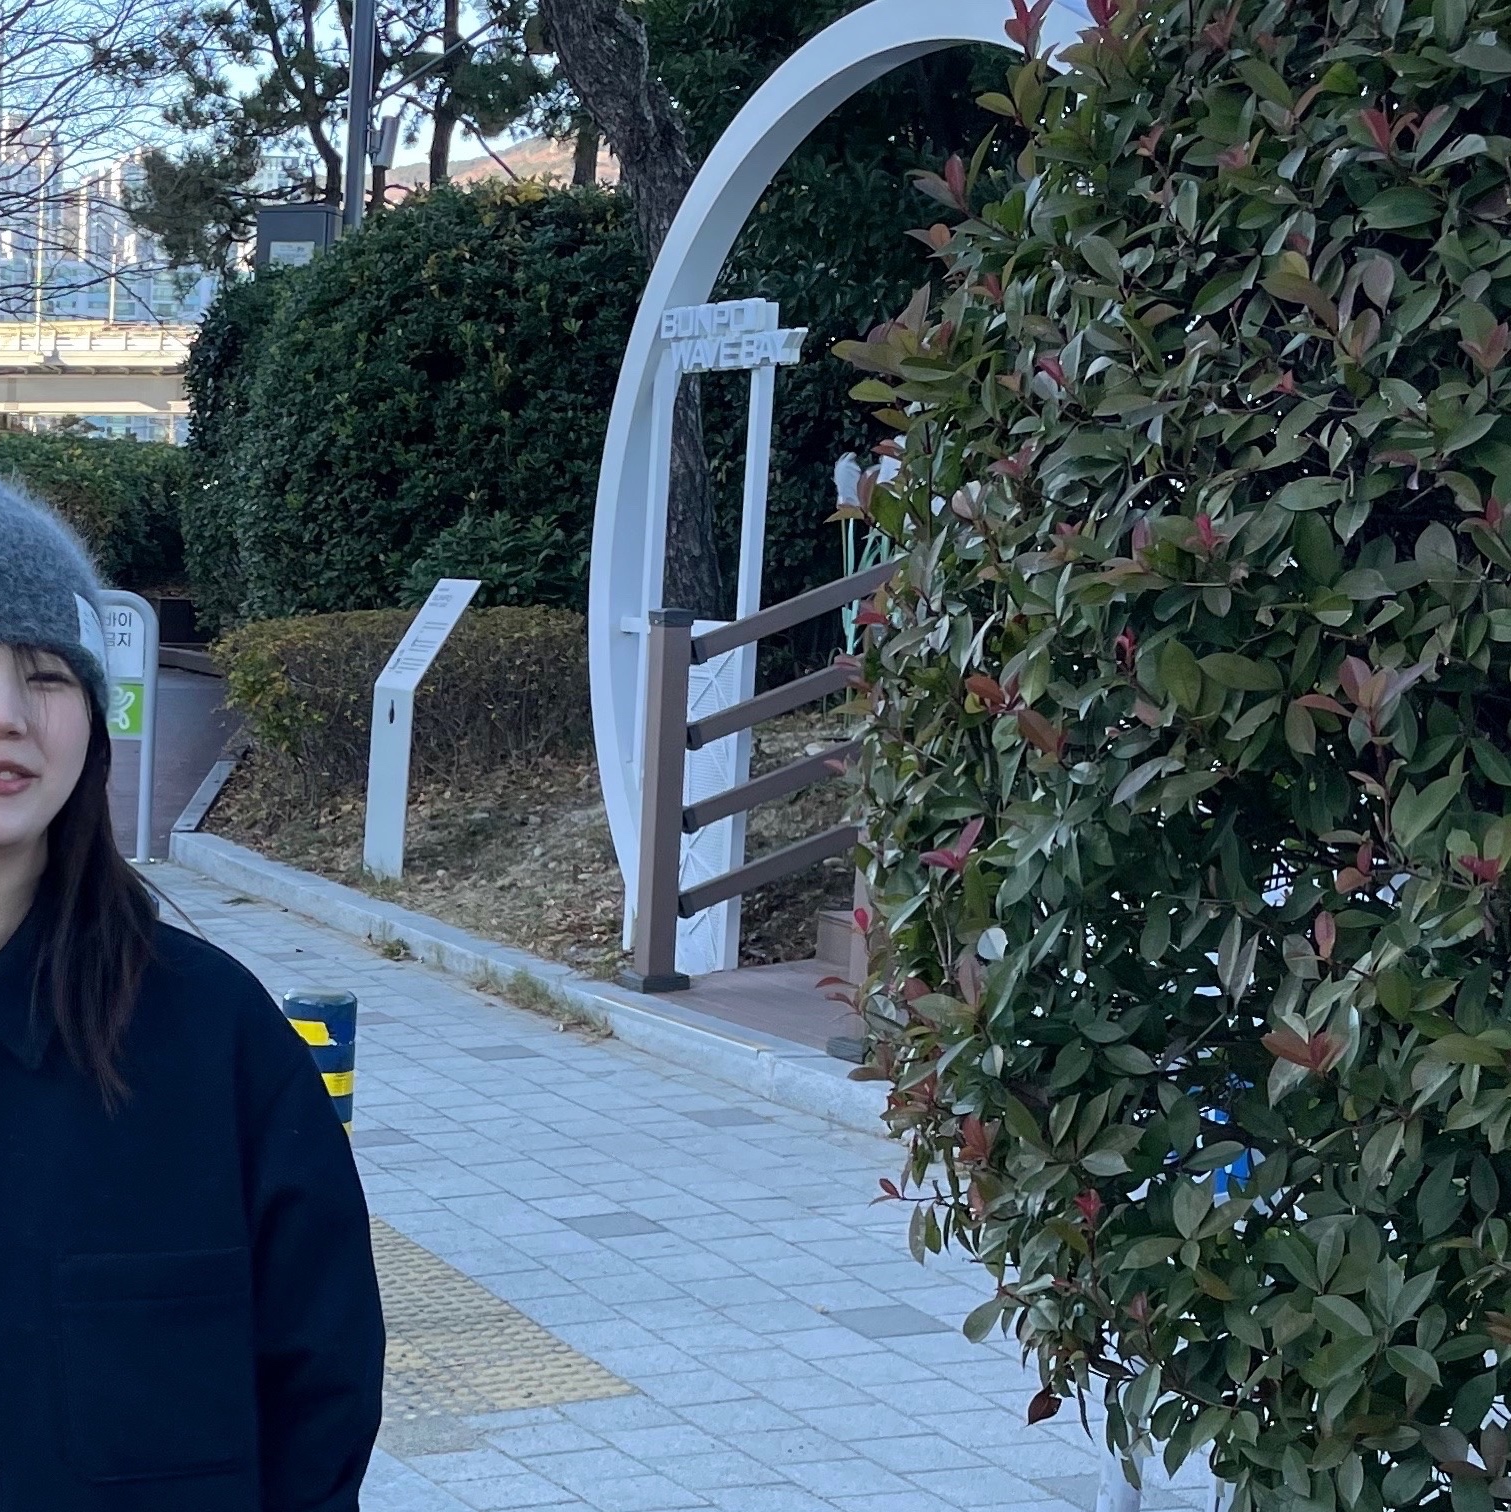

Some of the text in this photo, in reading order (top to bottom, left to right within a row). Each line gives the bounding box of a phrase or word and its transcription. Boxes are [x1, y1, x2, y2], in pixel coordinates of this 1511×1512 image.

[661, 298, 766, 339] BUNPO
[671, 328, 798, 371] WAVE BAY
